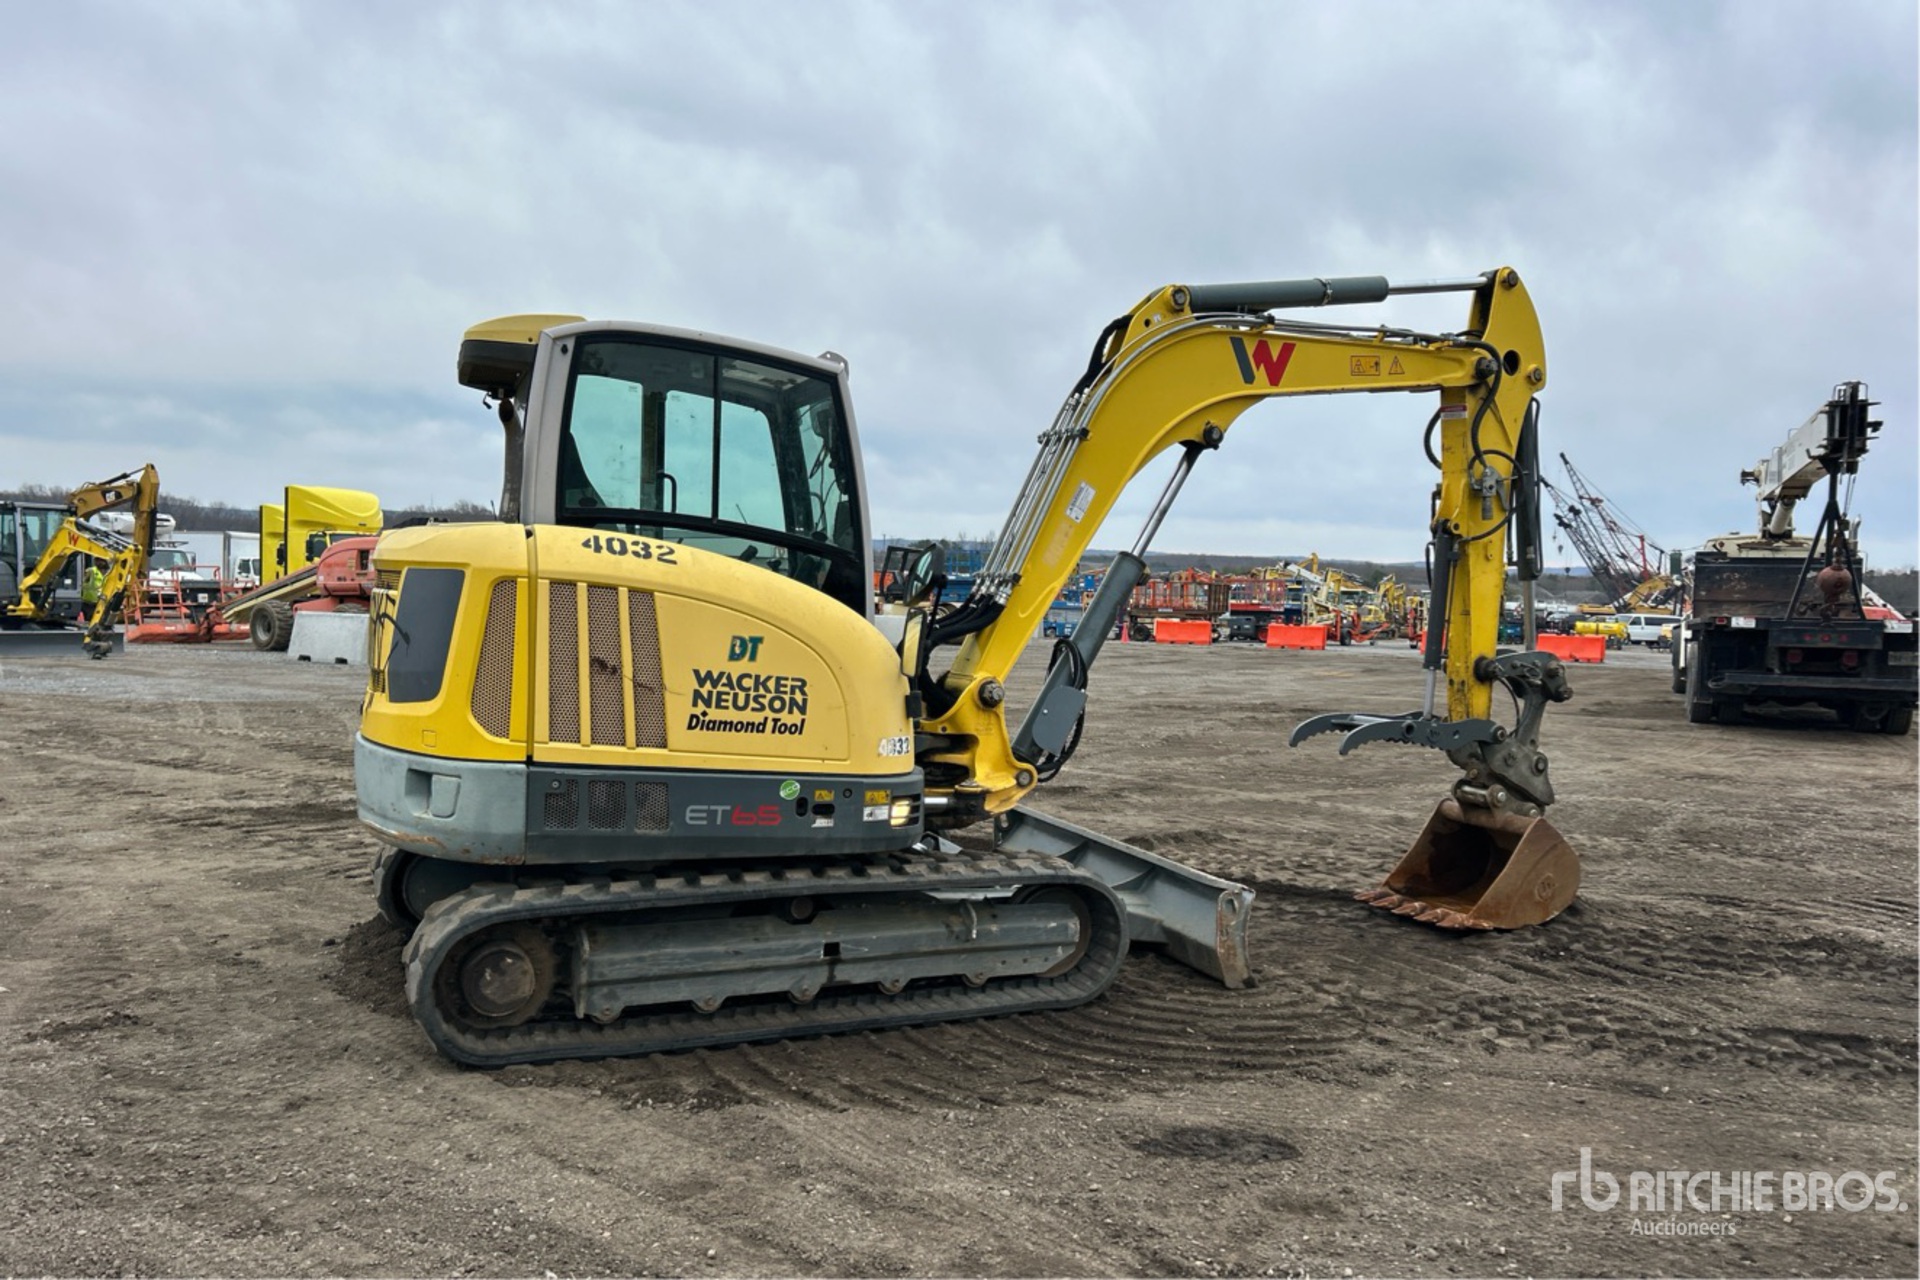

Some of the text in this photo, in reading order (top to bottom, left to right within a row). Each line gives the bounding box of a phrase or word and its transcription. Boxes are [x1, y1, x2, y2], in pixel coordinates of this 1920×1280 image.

[581, 535, 678, 565] 4032
[727, 635, 764, 662] DT
[692, 669, 808, 697] WACKER
[691, 688, 808, 716] NEUSON
[686, 710, 806, 735] Diamond Tool
[685, 804, 782, 826] ET65
